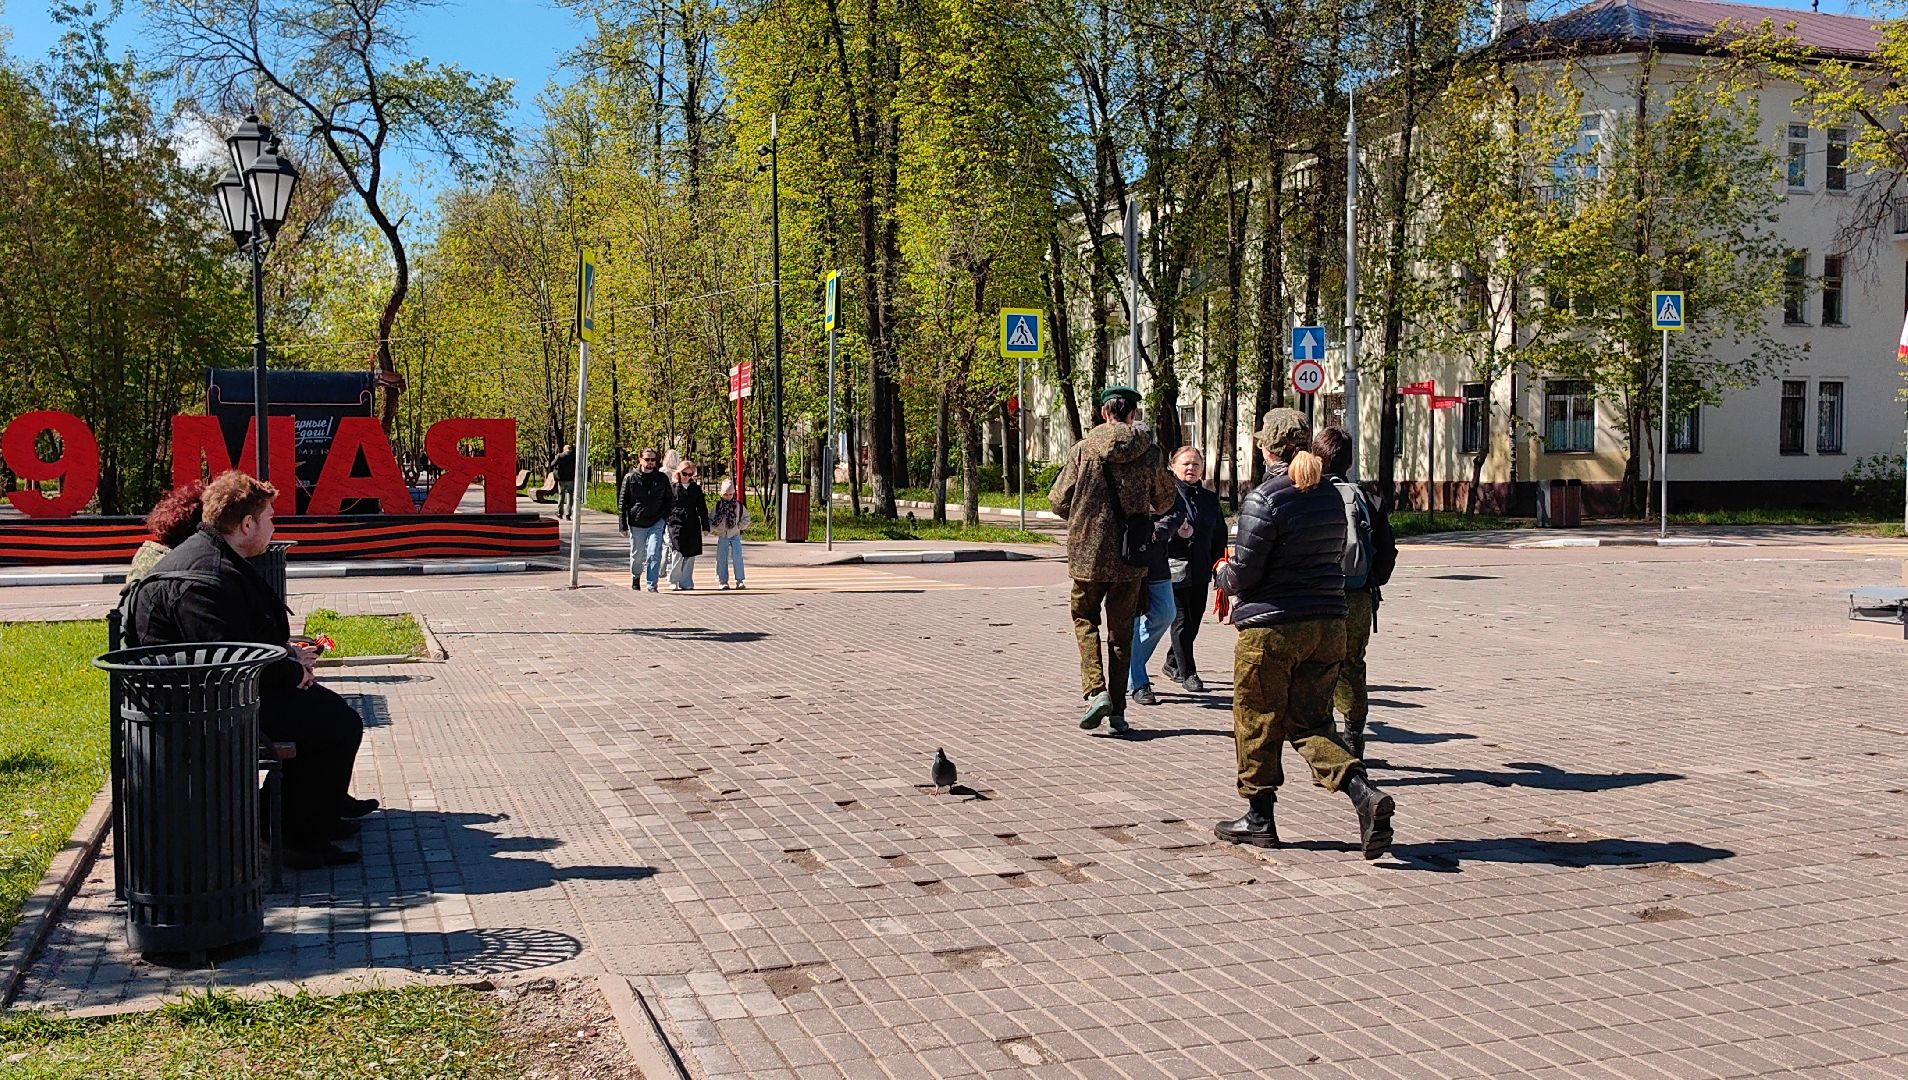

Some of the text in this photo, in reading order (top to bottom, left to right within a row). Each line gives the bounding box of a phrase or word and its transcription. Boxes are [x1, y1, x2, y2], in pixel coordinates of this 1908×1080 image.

[1299, 370, 1318, 384] 40
[295, 419, 327, 431] арные
[1, 410, 517, 517] 9 МАЯ
